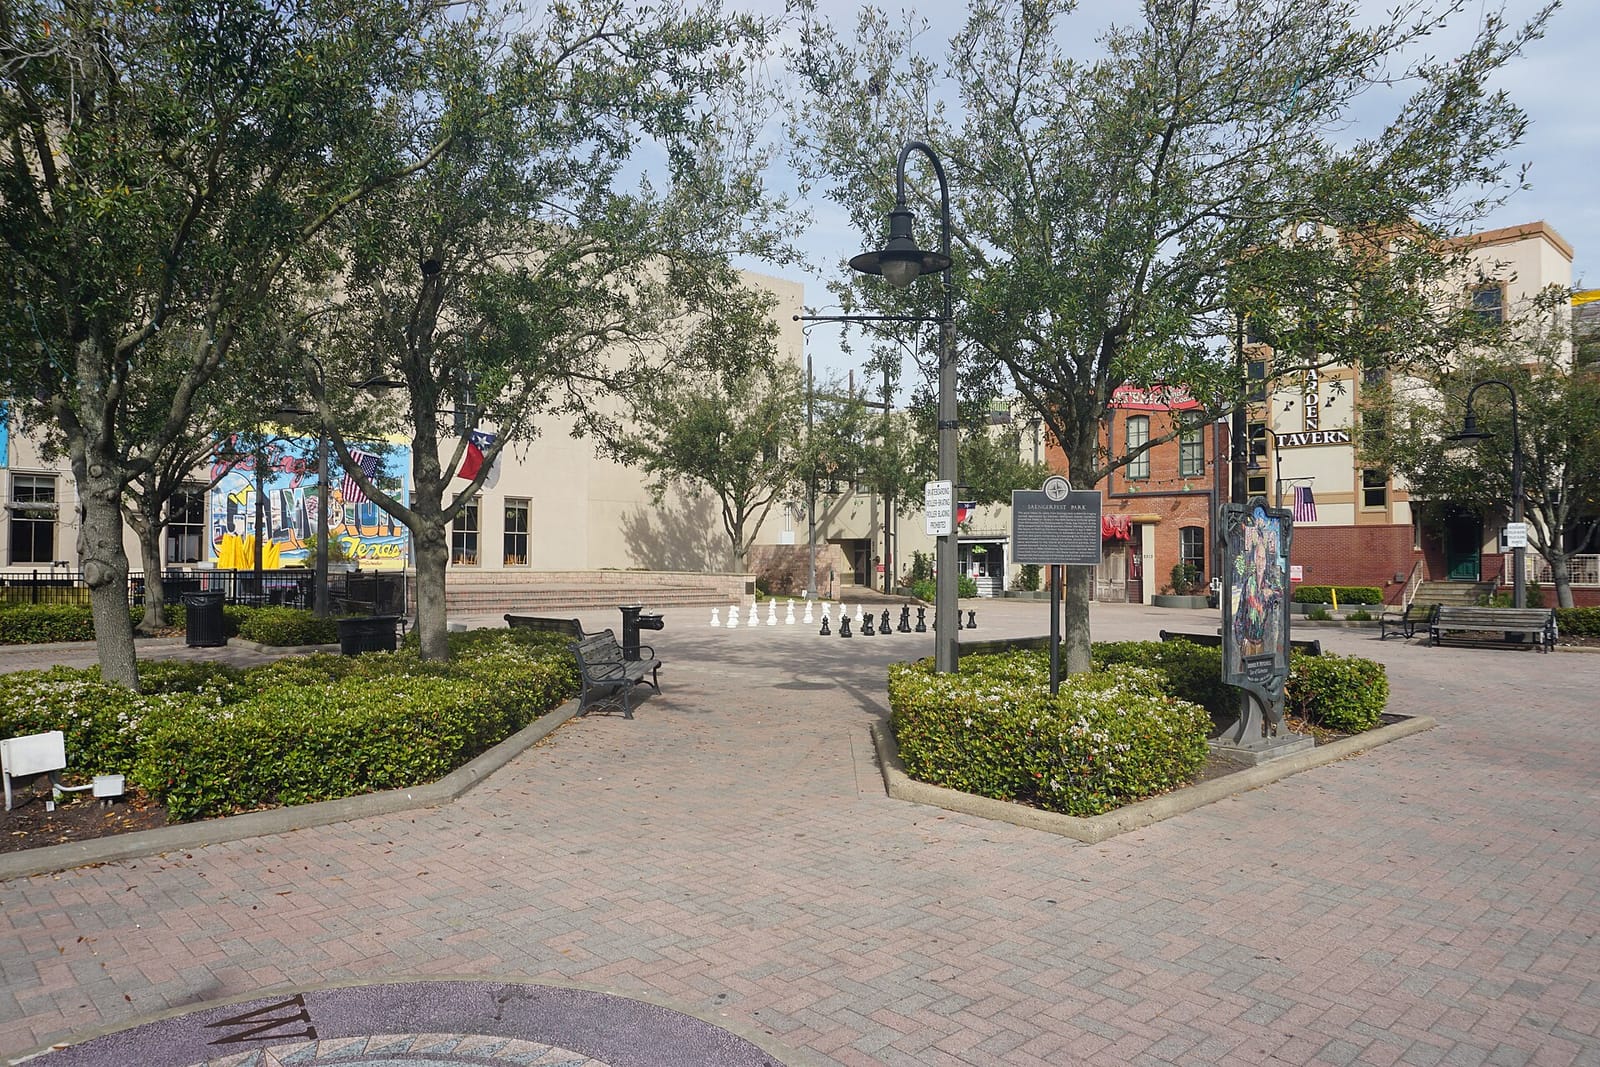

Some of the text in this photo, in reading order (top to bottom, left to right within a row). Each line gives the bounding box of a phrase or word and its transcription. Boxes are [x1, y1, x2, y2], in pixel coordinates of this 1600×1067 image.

[1276, 431, 1349, 447] TAVERN
[341, 536, 401, 558] Texas
[204, 993, 318, 1046] W
